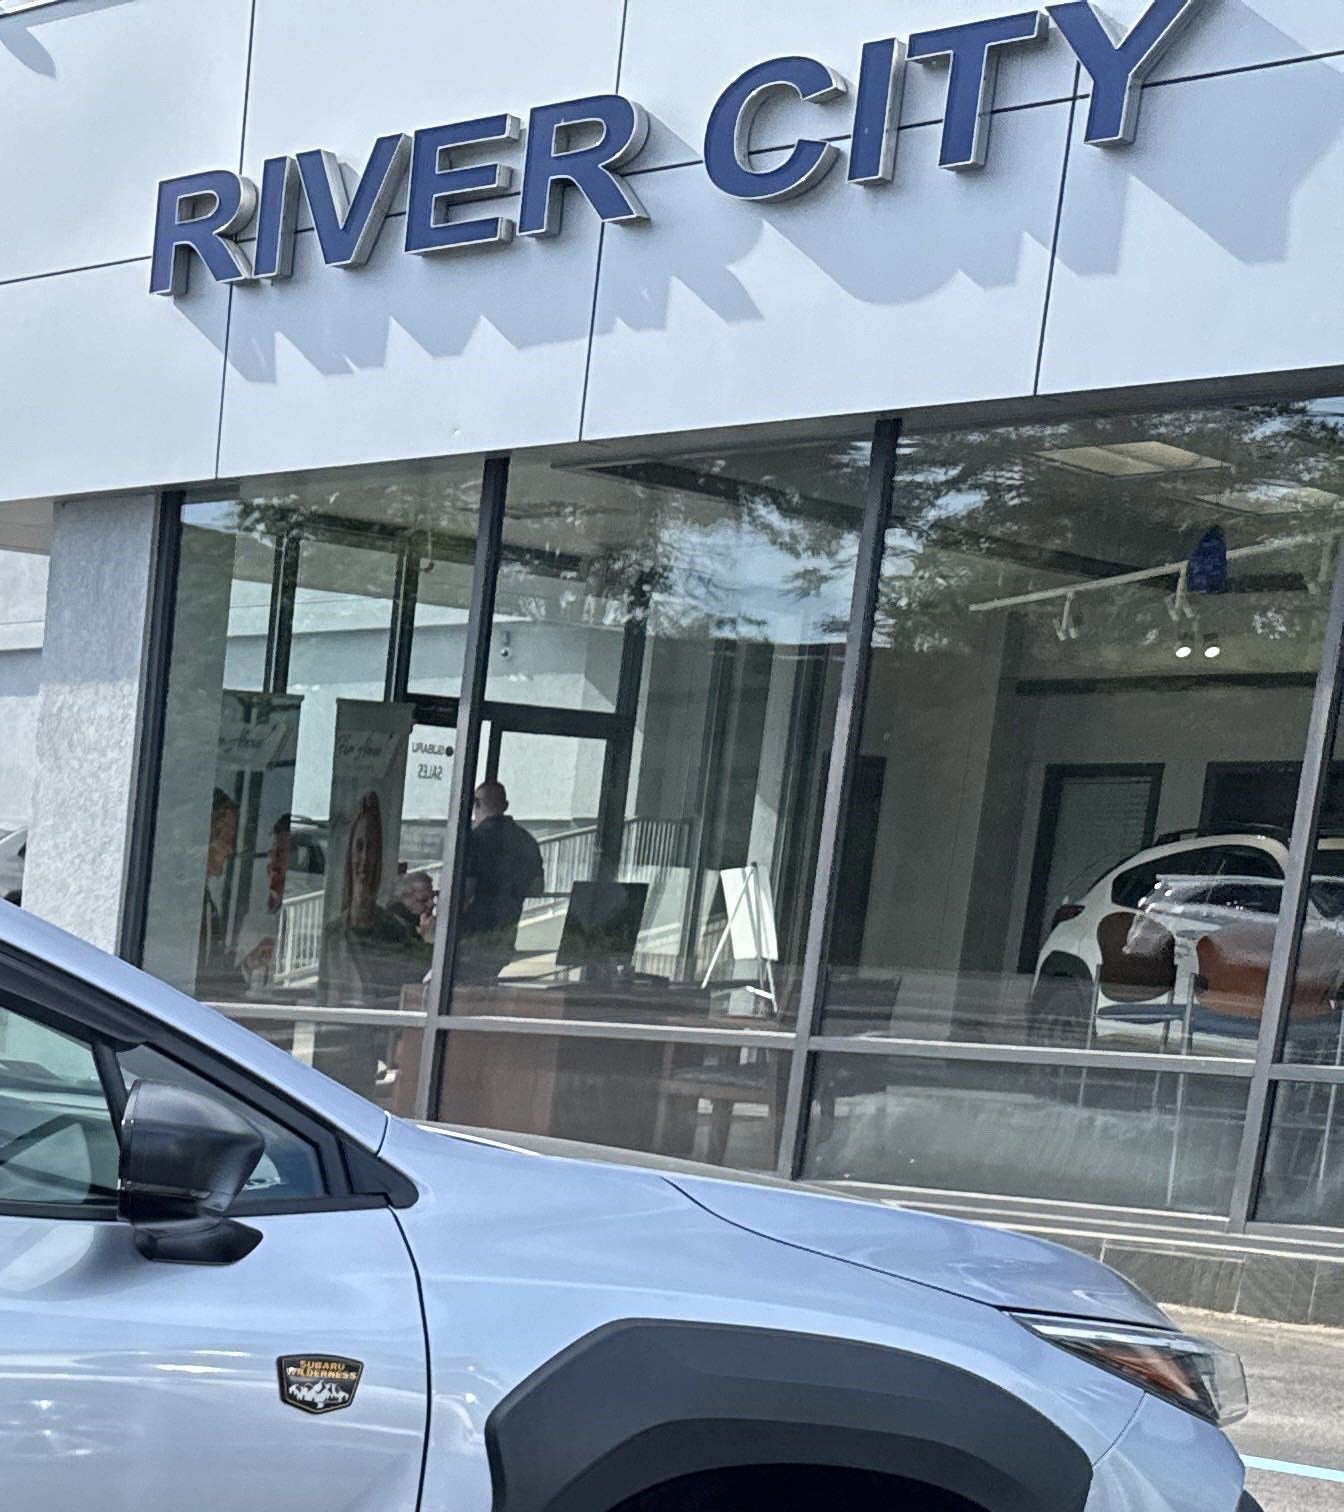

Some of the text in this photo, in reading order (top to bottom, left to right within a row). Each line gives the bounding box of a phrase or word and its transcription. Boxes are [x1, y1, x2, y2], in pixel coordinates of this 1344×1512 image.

[149, 0, 1195, 297] RIVER CITY
[299, 1359, 346, 1371] SUBARU
[286, 1366, 358, 1380] WILDERNESS
